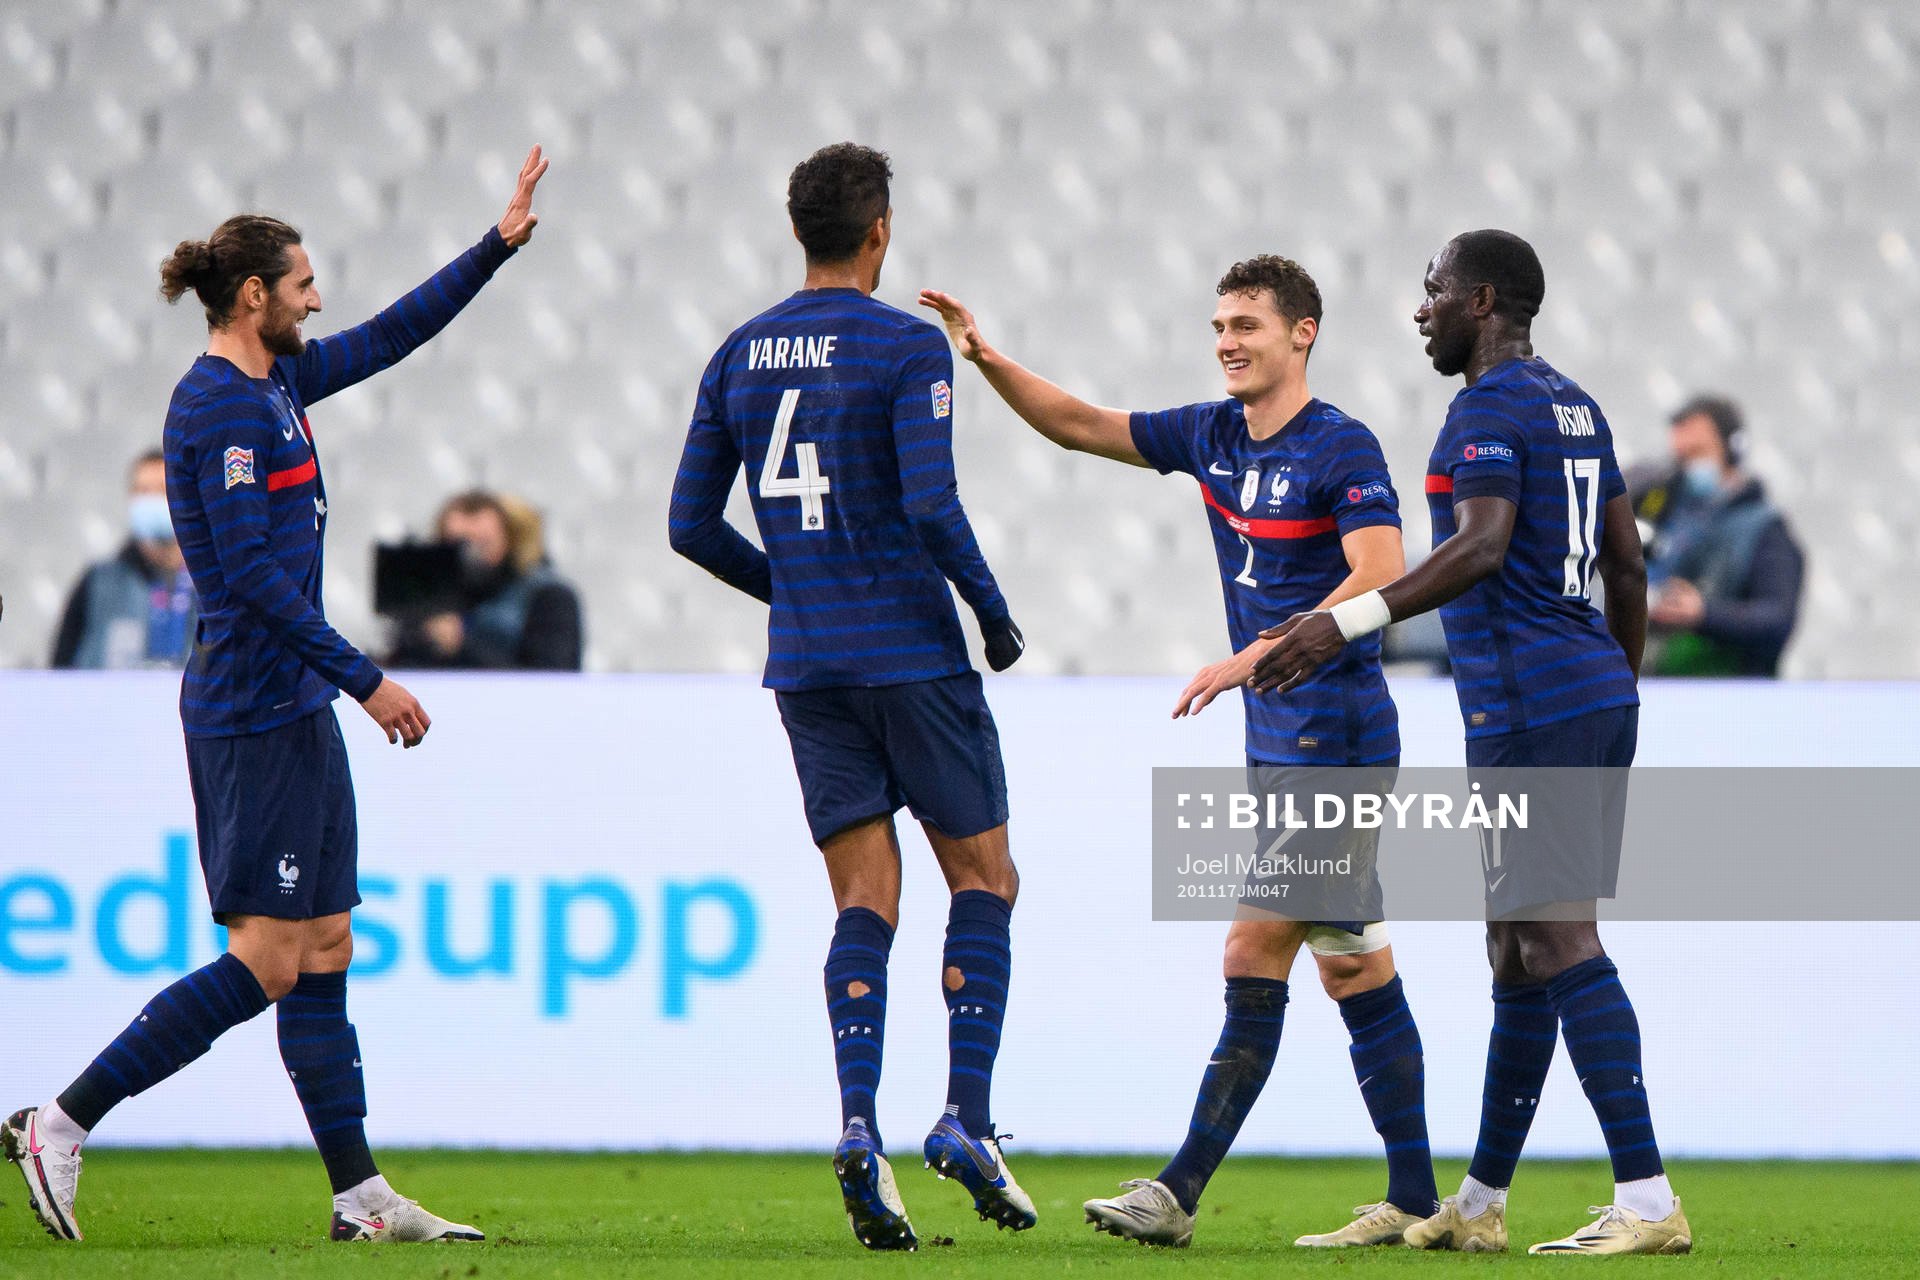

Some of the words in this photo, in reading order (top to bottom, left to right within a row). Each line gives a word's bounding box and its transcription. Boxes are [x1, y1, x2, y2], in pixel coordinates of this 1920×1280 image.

[748, 336, 838, 370] VARANE
[759, 389, 830, 530] 4
[1478, 446, 1513, 458] RESPECT
[1562, 458, 1600, 599] 17
[1234, 533, 1257, 588] 2
